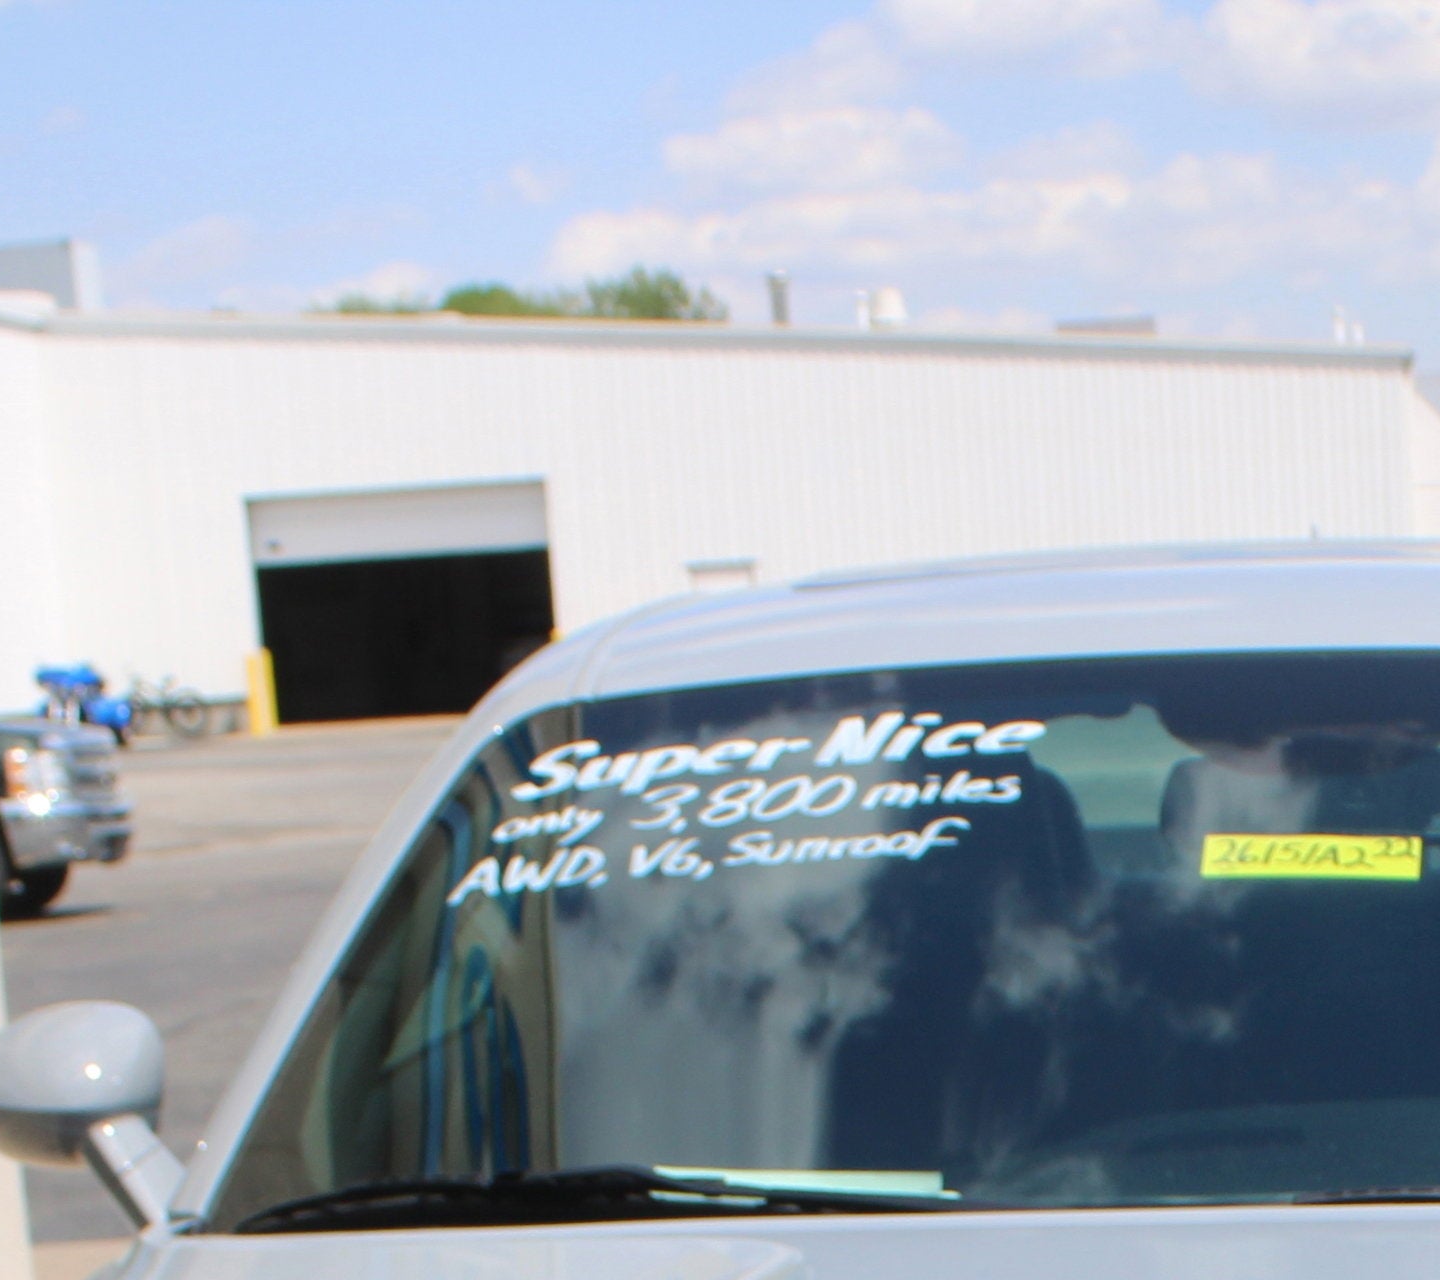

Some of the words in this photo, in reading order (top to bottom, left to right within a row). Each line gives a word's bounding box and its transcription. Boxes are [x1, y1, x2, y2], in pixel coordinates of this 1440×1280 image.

[510, 737, 812, 802] Super
[814, 711, 1048, 768] Nice
[629, 774, 858, 834] 3,800
[862, 770, 1023, 811] miles
[723, 816, 972, 868] Sunroof
